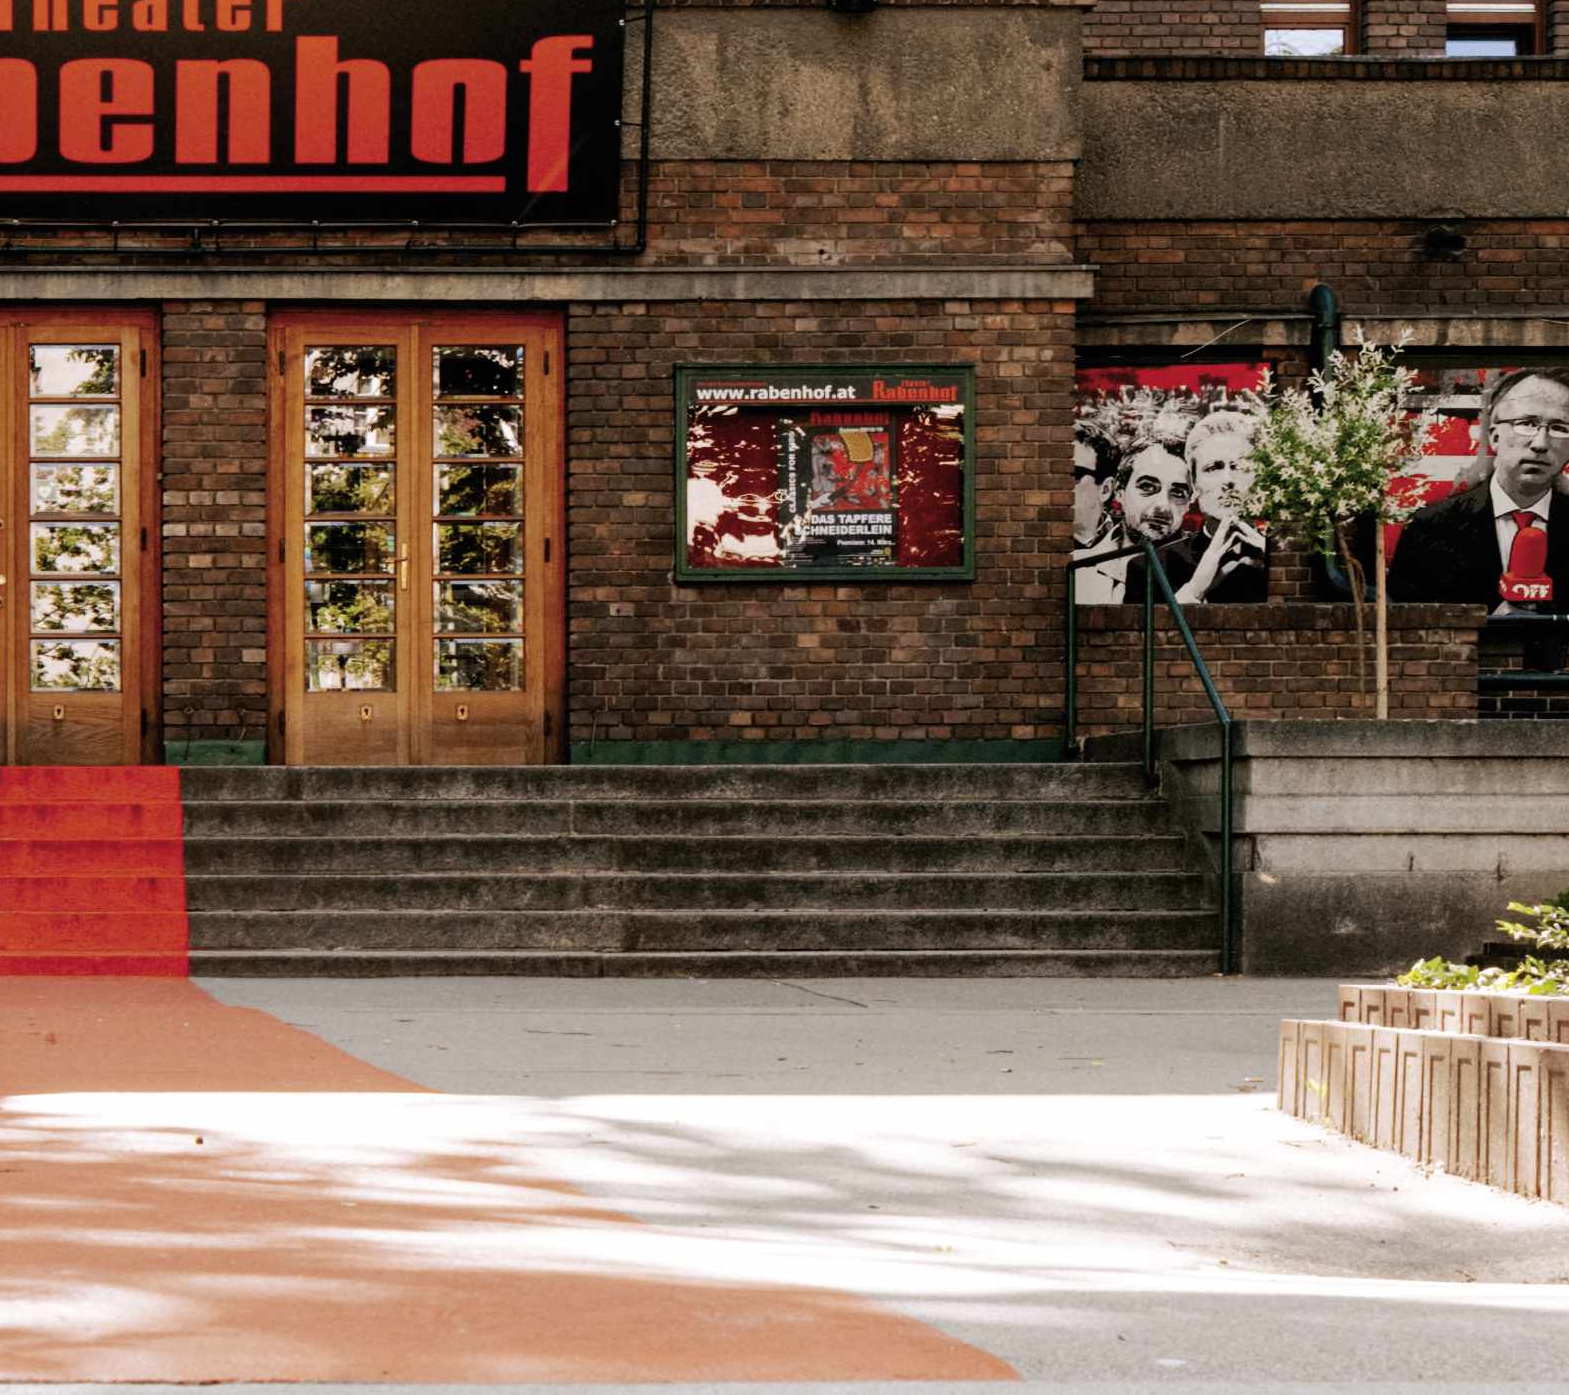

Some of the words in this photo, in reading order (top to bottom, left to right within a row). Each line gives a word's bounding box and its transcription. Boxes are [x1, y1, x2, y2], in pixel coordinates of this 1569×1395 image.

[696, 385, 856, 400] www.rabenhof.at
[871, 380, 958, 402] Rabenhof
[811, 513, 835, 524] DAS
[837, 513, 893, 524] TAPFERE
